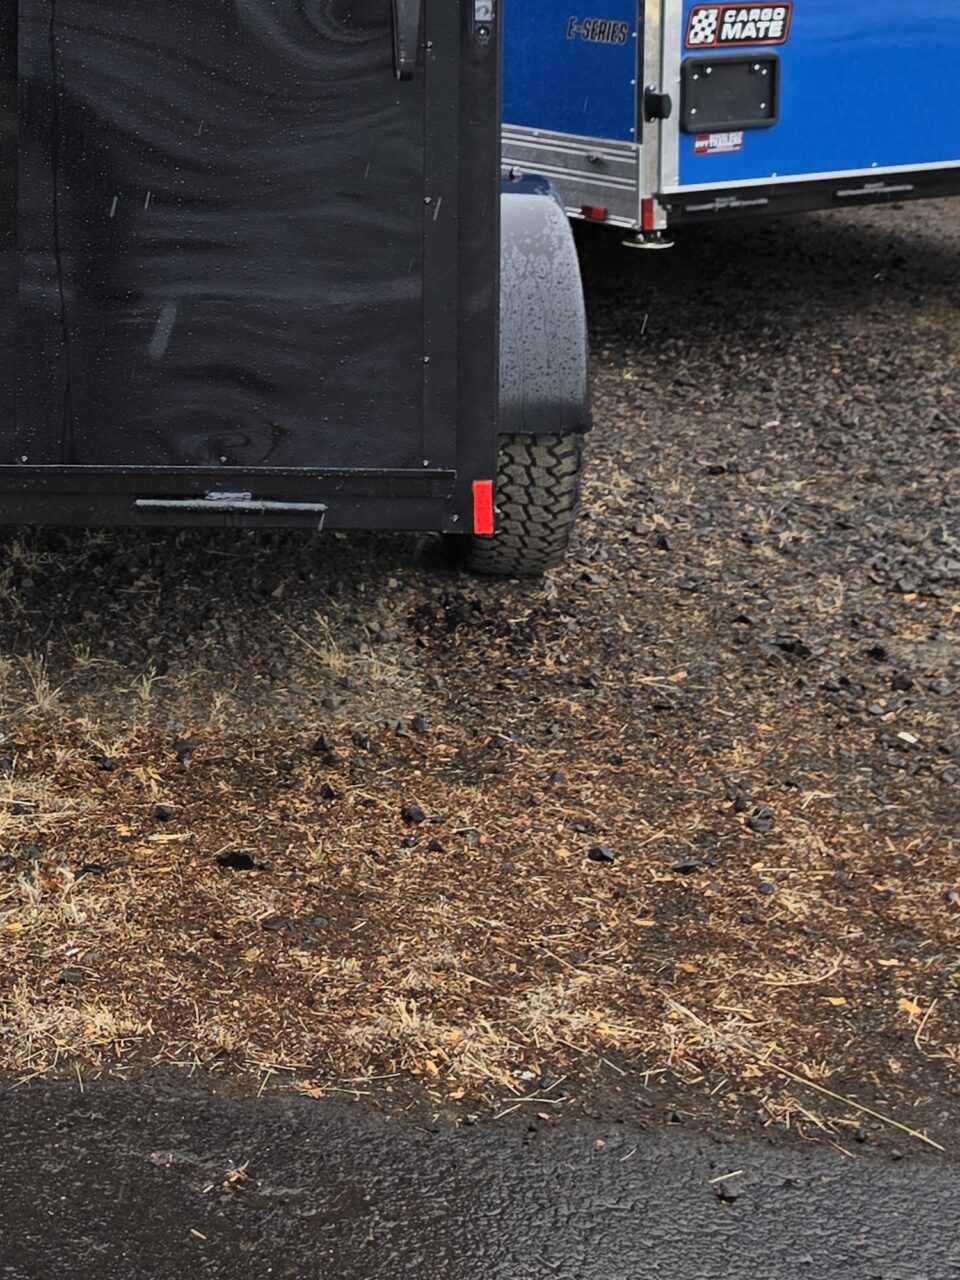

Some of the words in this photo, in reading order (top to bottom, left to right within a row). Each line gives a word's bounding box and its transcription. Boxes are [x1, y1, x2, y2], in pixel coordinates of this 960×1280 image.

[724, 7, 786, 23] CARGO
[567, 17, 628, 44] E-SERIES
[721, 21, 784, 40] MATE
